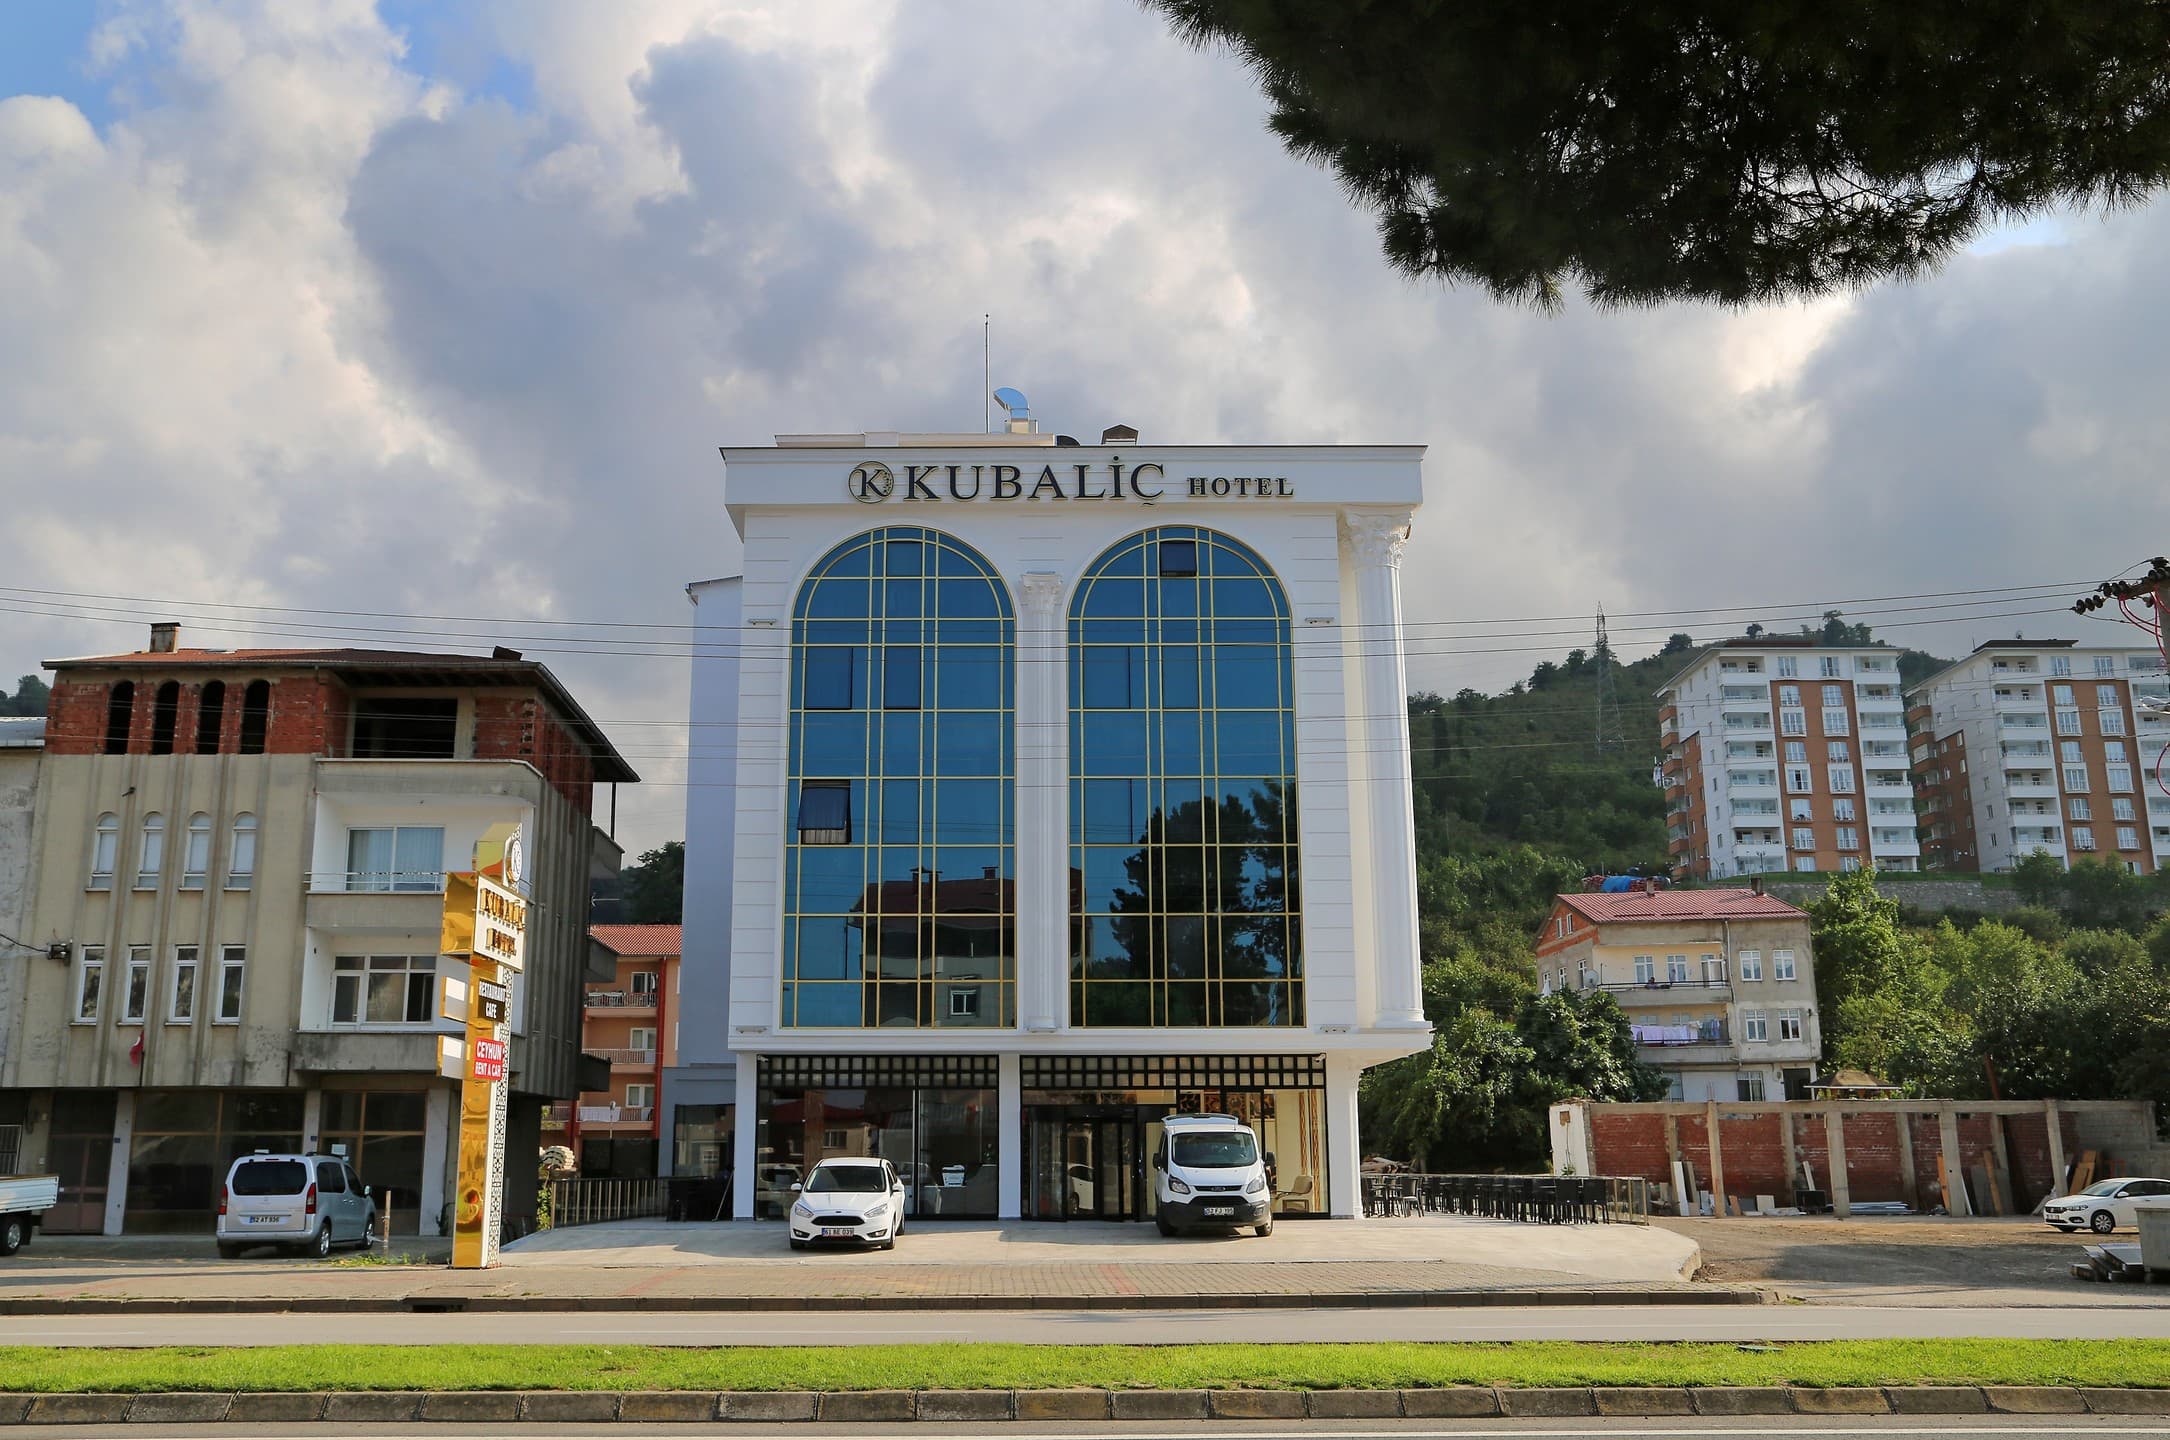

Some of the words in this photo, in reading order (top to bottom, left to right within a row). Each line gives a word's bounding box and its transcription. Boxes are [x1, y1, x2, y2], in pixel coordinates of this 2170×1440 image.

[903, 456, 1164, 506] KUBALİÇ
[1187, 477, 1294, 496] HOTEL
[485, 1002, 497, 1019] CAFE
[476, 1041, 503, 1060] CEYHUN
[475, 1062, 487, 1075] RENT
[491, 1064, 501, 1077] CAR
